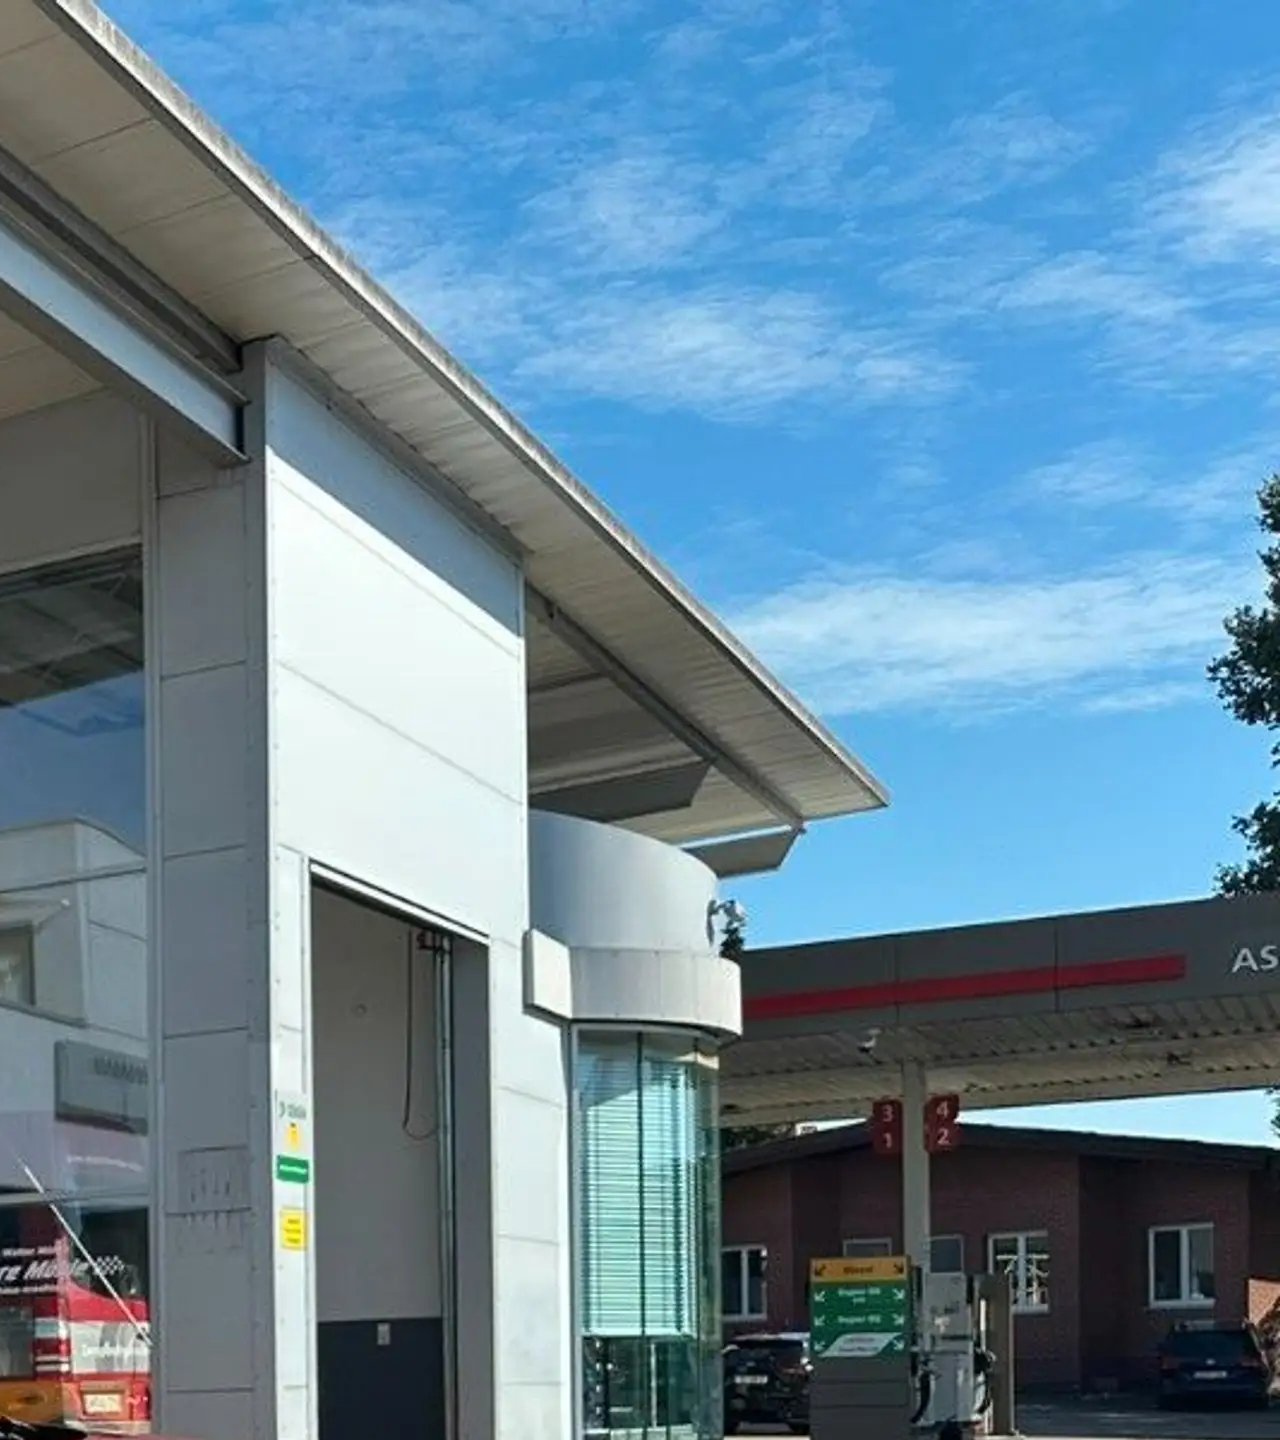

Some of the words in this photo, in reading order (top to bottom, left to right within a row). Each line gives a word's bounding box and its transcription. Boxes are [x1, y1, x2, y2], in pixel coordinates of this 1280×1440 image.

[882, 1103, 893, 1121] 3
[936, 1101, 949, 1118] 4
[883, 1132, 892, 1149] 1
[937, 1128, 950, 1146] 2
